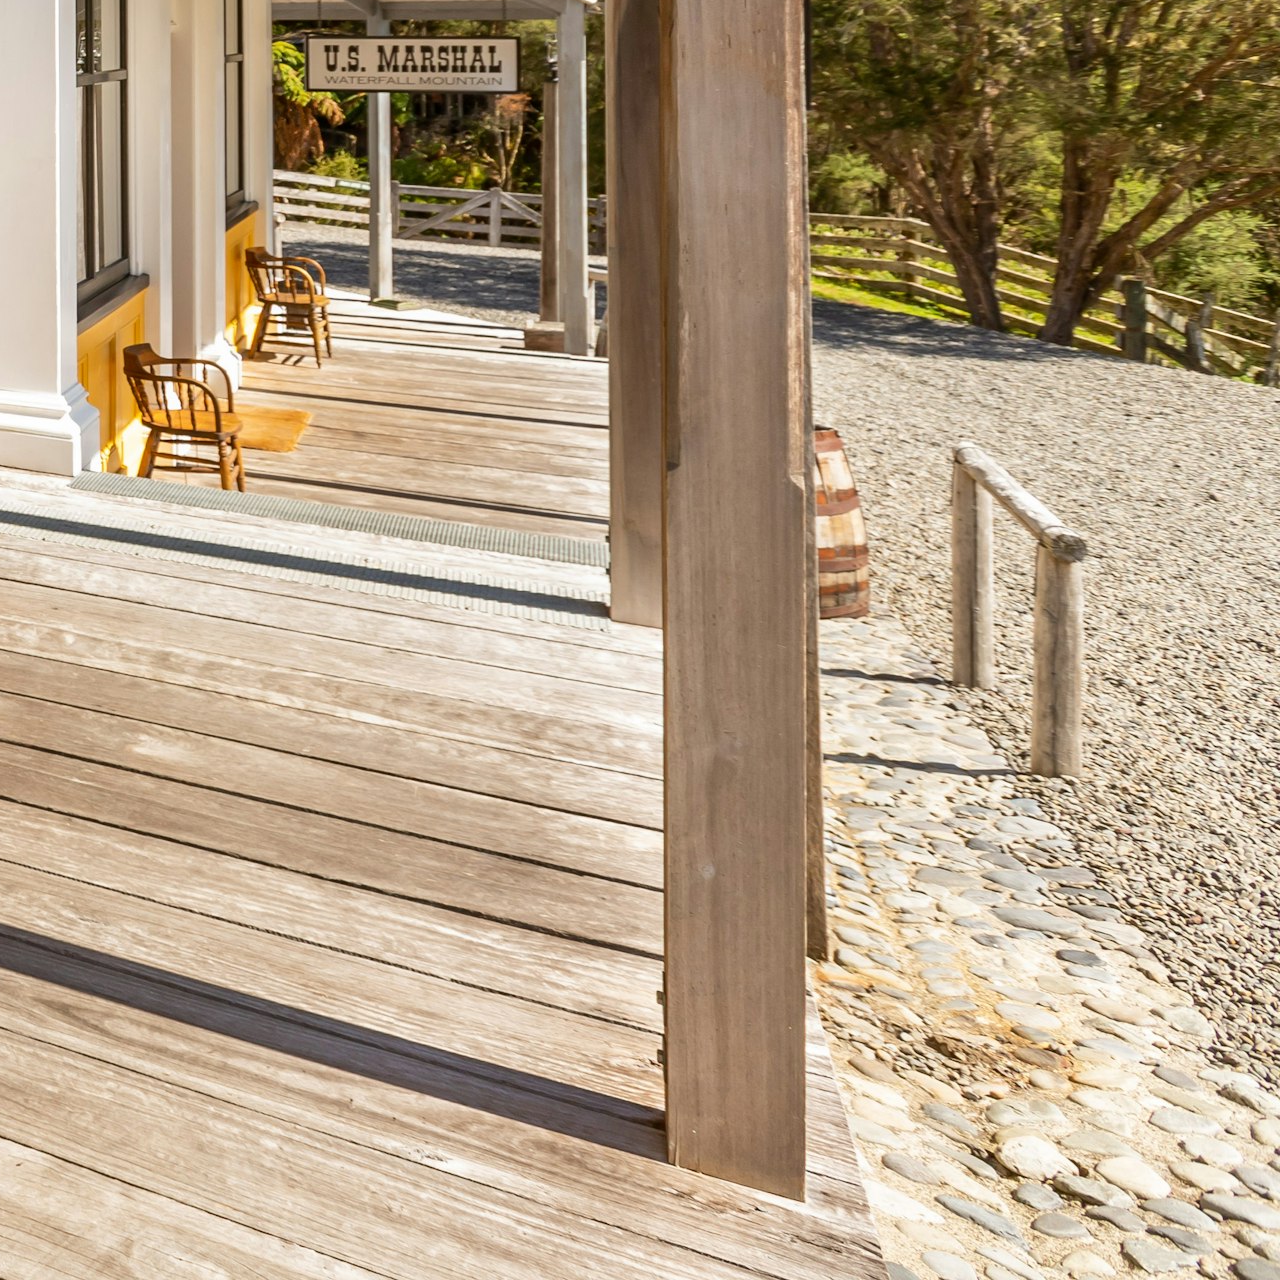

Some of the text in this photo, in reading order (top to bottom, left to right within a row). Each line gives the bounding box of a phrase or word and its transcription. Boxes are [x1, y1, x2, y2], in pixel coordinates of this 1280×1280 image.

[324, 44, 502, 73] U.S. MARSHAL
[324, 75, 503, 86] WATERFALL MOUNTAIN
